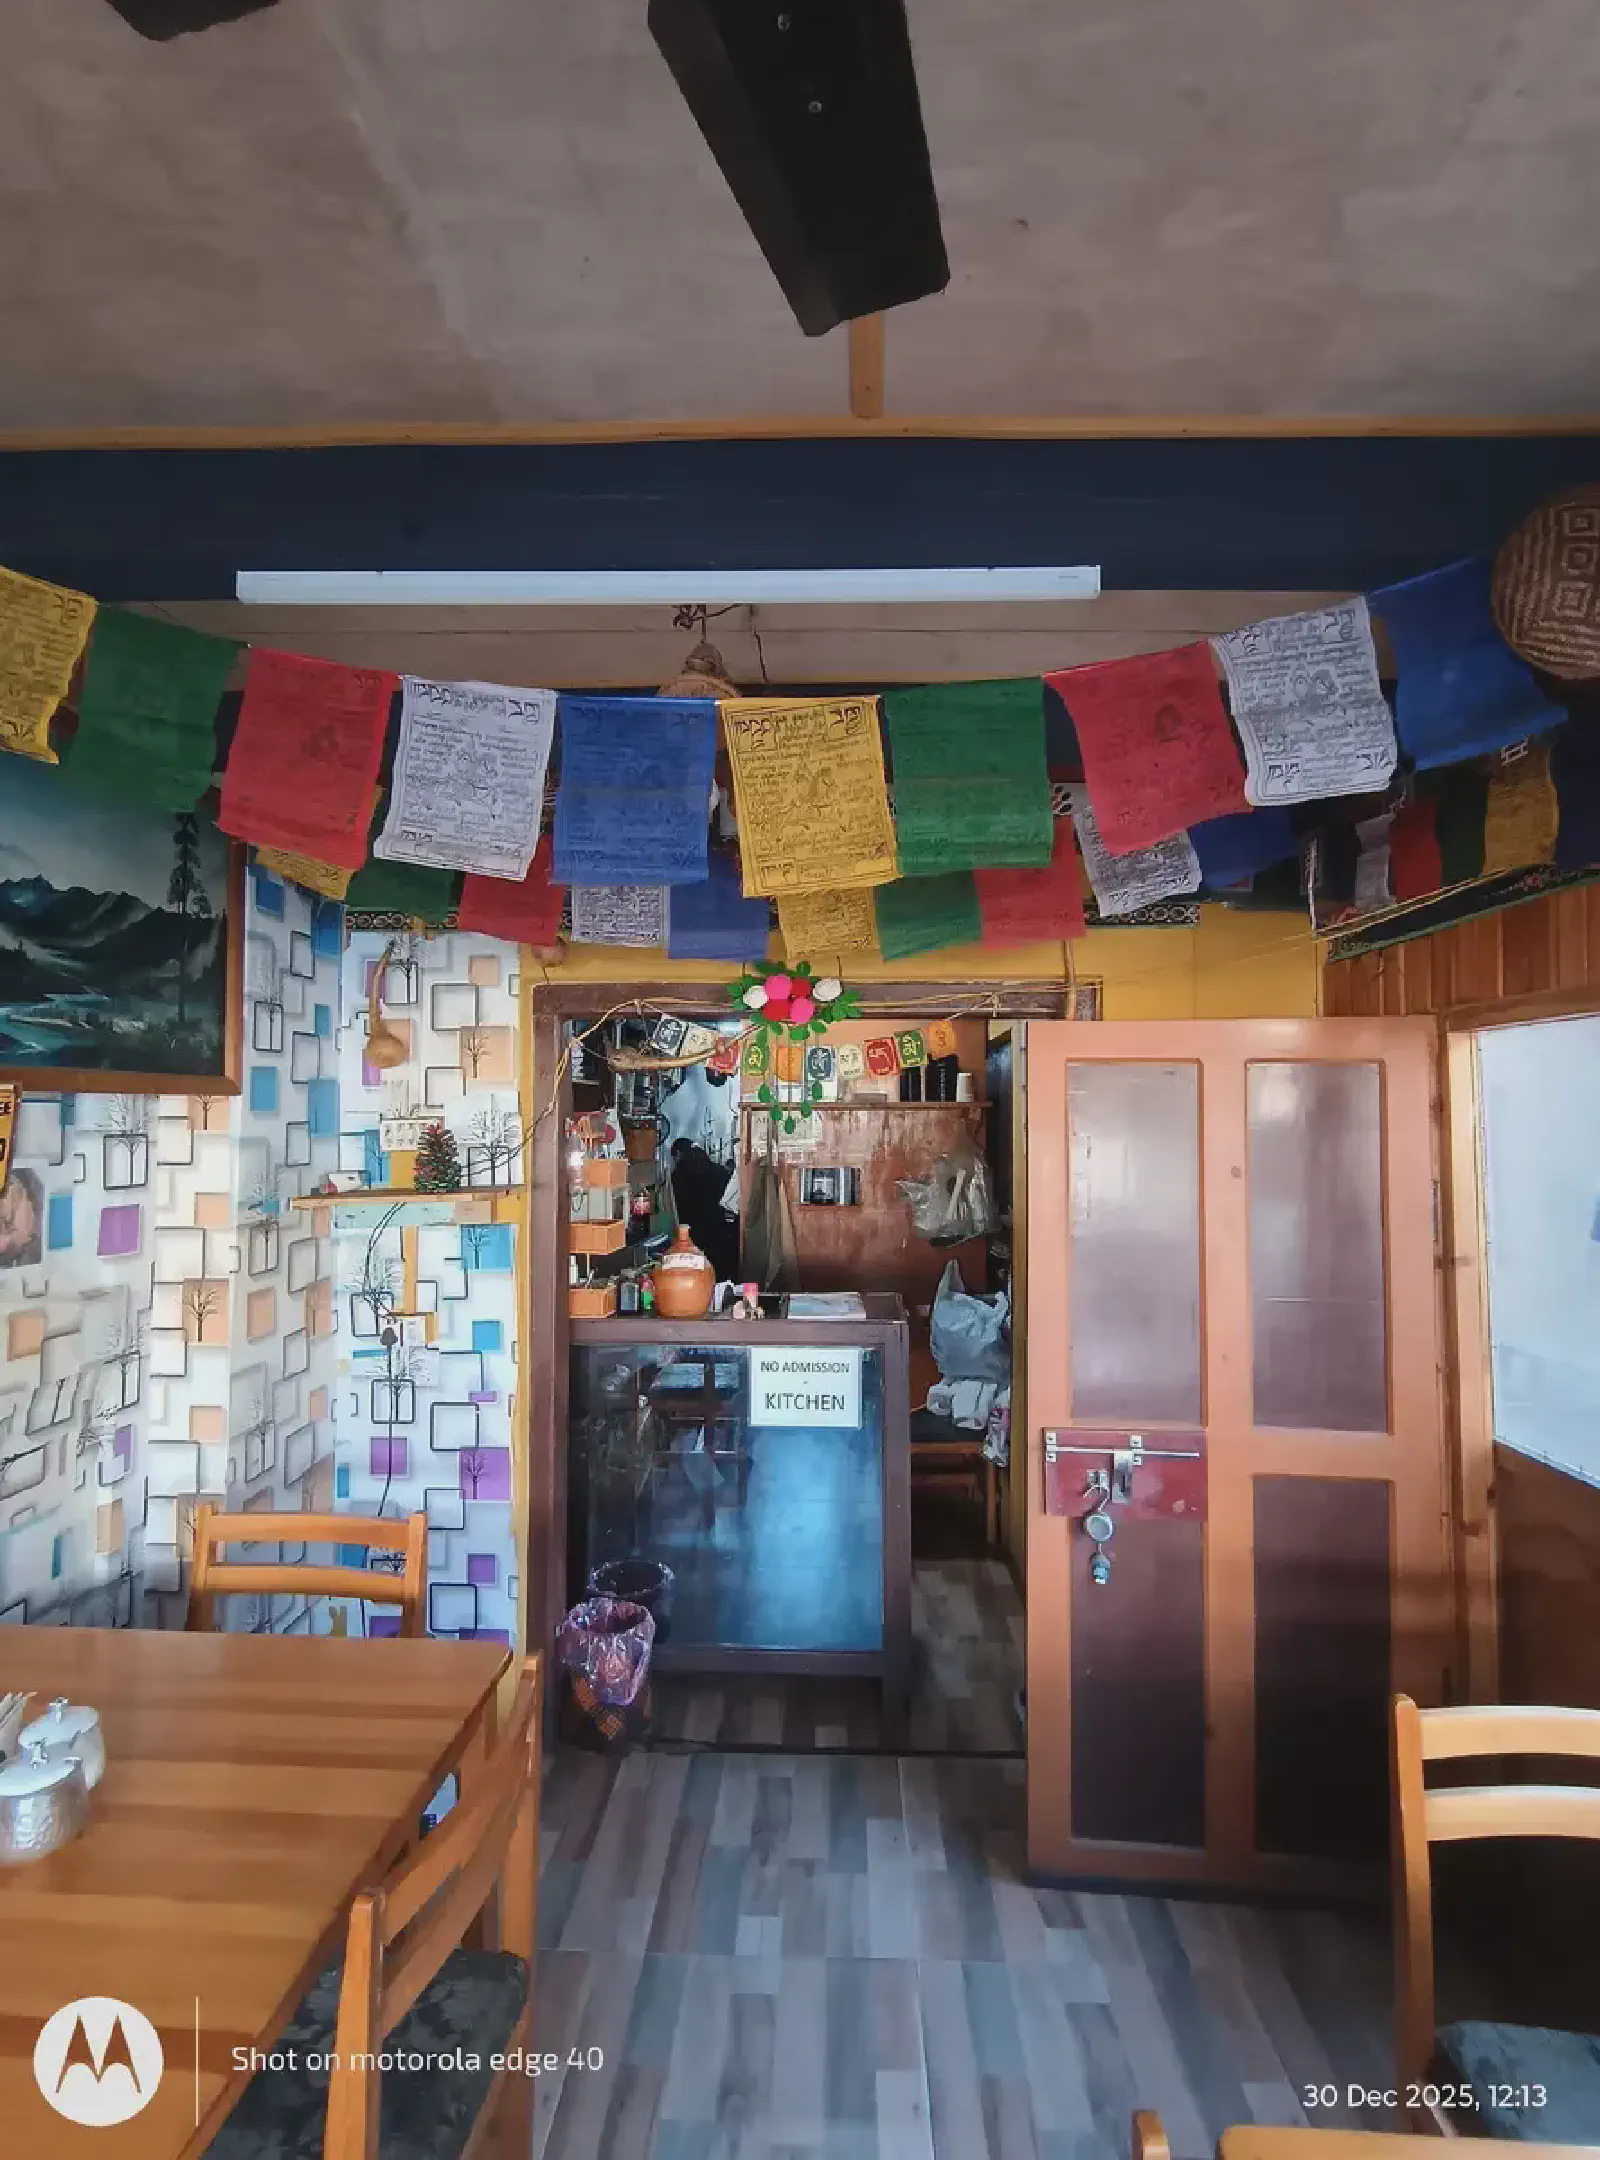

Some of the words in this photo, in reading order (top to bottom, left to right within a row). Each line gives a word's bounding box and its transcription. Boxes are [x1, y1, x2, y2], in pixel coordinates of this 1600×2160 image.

[760, 1360, 779, 1373] NO
[782, 1361, 850, 1374] ADMISSION
[764, 1392, 846, 1411] KITCHEN
